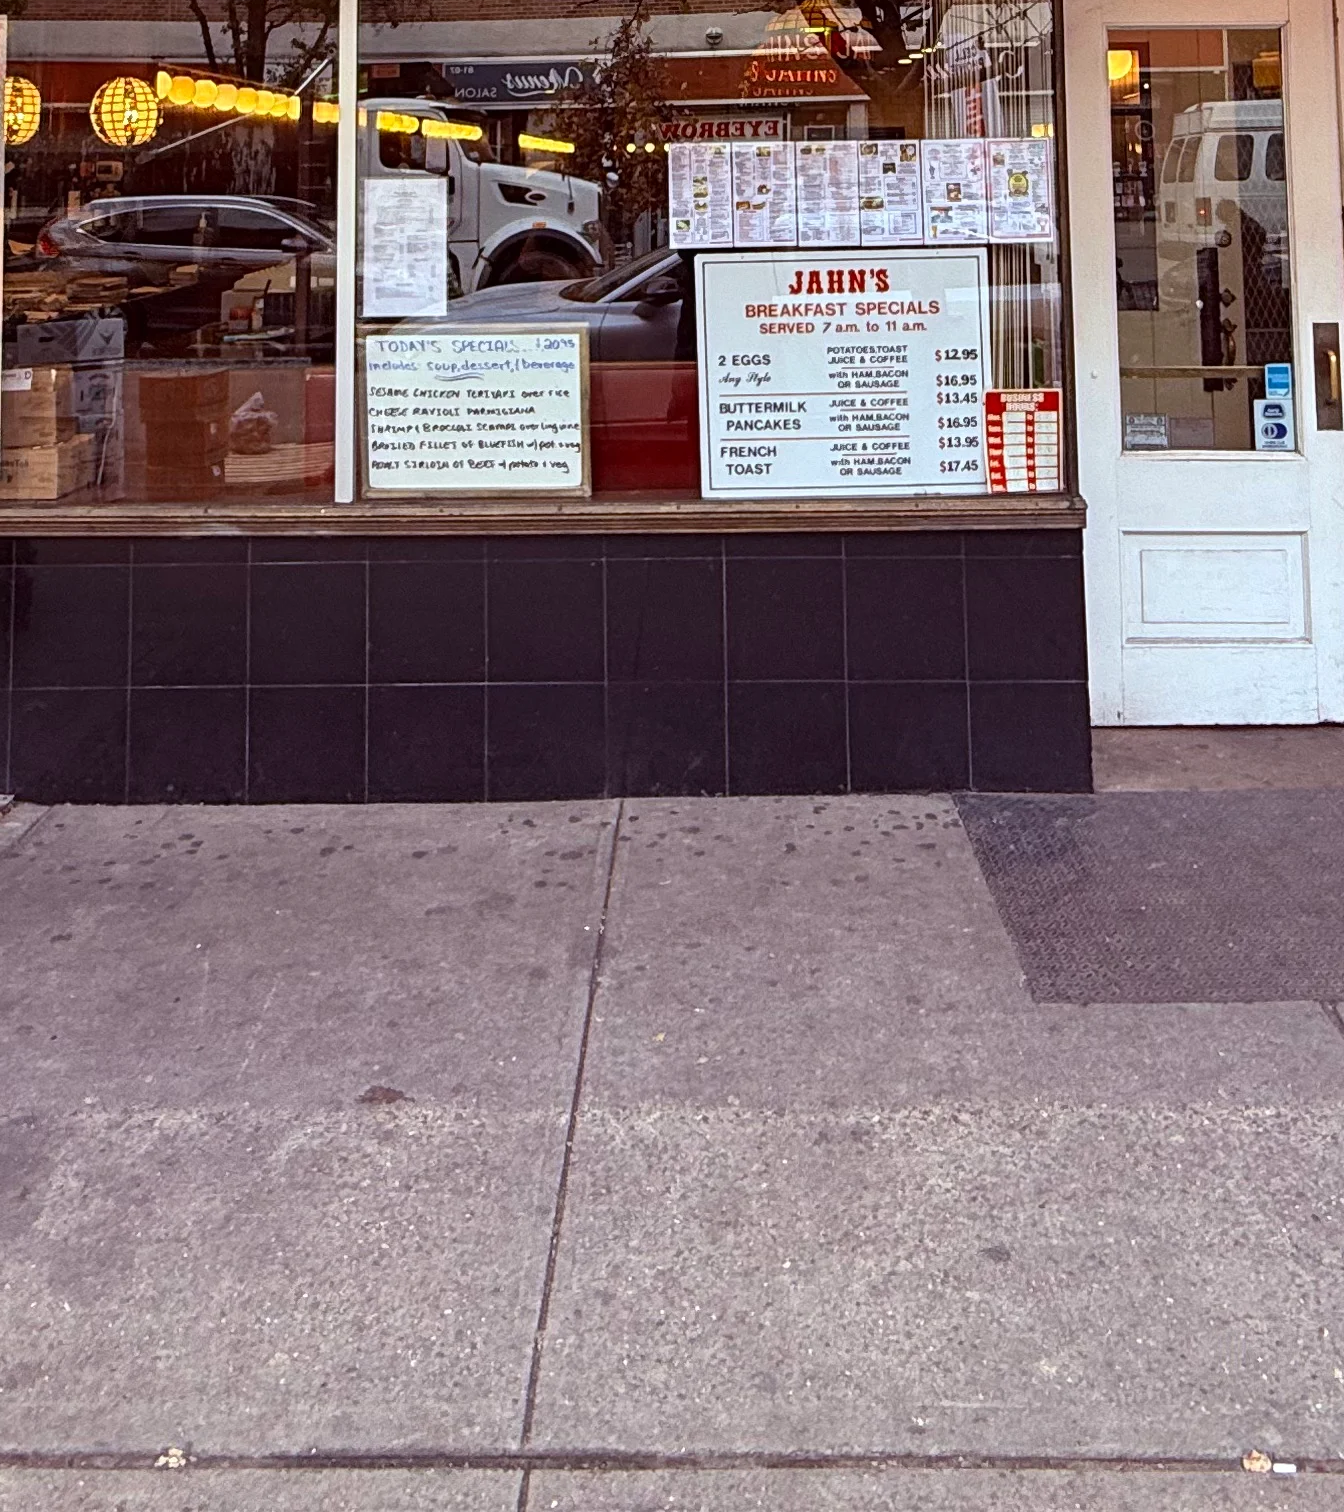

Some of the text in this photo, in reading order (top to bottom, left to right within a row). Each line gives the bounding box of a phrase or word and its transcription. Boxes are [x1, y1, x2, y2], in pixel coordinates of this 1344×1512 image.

[788, 268, 890, 295] JAHN'S
[745, 300, 940, 318] BREAKFAST SPECIALS
[759, 321, 896, 334] SERVED 7 to 11
[376, 339, 442, 353] TODAY'S
[718, 354, 771, 367] 2 EGGS
[827, 355, 908, 365] JUICE COFFEE
[718, 372, 741, 387] Any
[828, 370, 849, 380] with
[837, 379, 901, 389] OR SAUSAGE
[829, 398, 908, 408] JUICE COFFEE
[936, 391, 978, 405] $13.45
[412, 408, 460, 417] RAVIOLI
[719, 401, 807, 414] BUTTERMILK
[829, 413, 849, 422] with
[726, 418, 801, 431] PANCAKES
[838, 423, 901, 432] OR SAUSAGE
[420, 440, 457, 450] FILLET
[830, 442, 910, 452] JUICE COFFEE
[720, 445, 777, 458] FRENCH
[830, 458, 851, 467] with
[726, 463, 773, 475] TOAST
[839, 467, 902, 476] OR SAUSAGE
